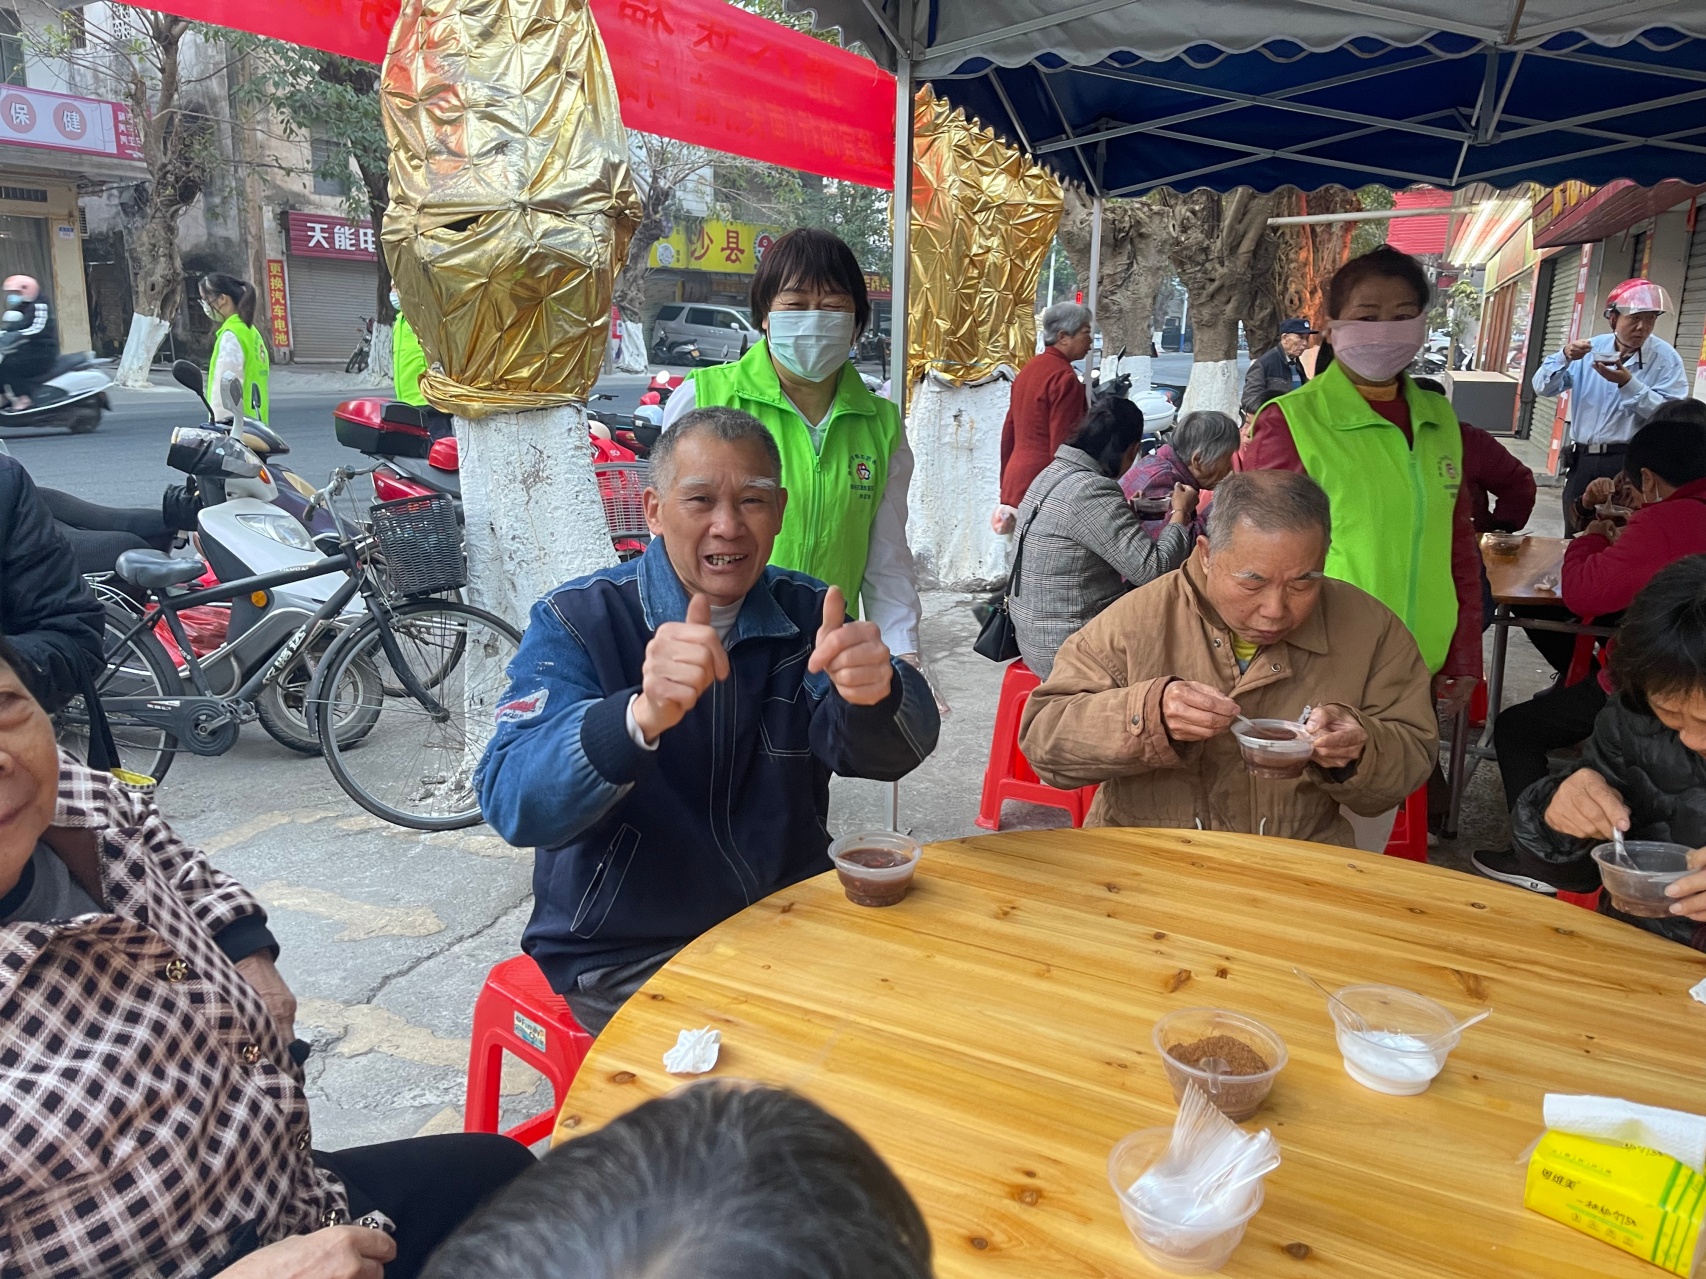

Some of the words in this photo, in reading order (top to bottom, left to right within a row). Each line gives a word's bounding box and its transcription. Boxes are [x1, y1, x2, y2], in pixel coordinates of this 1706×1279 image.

[10, 102, 81, 132] 保健
[306, 222, 377, 252] 天能电
[688, 226, 745, 264] 沙县
[269, 262, 288, 345] 更换汽车电池
